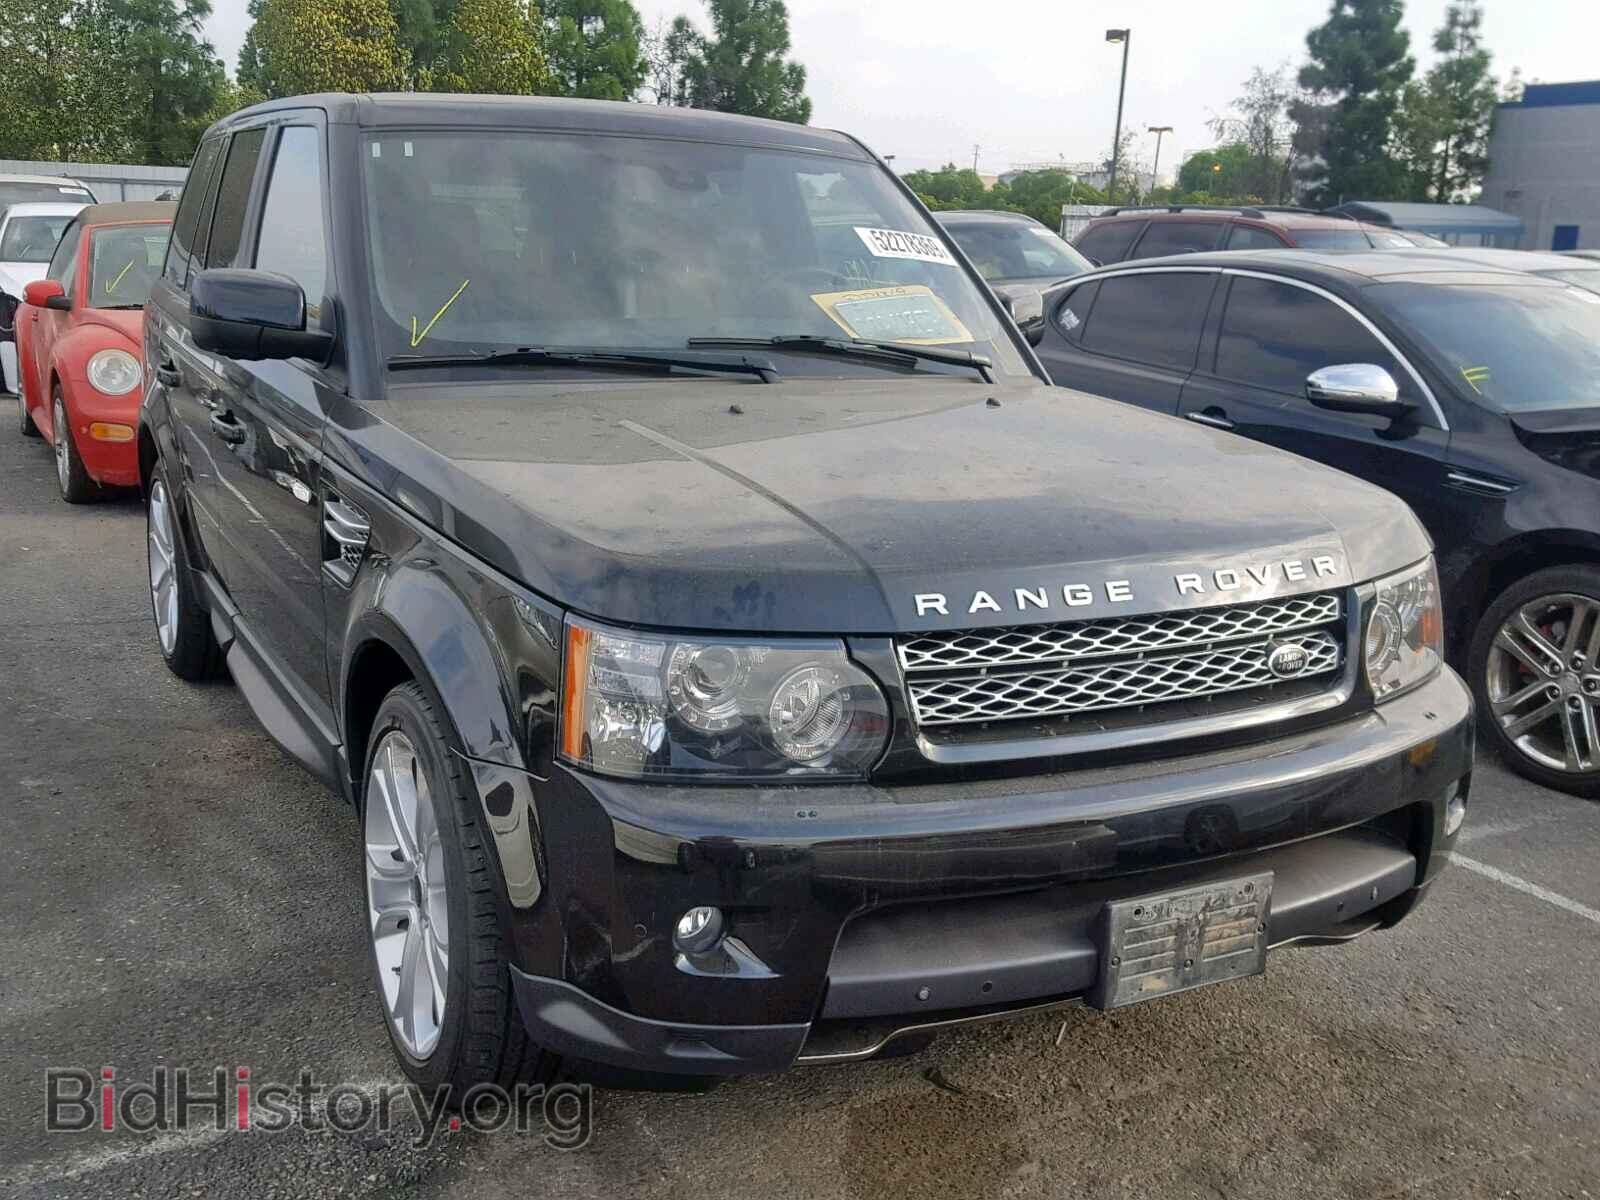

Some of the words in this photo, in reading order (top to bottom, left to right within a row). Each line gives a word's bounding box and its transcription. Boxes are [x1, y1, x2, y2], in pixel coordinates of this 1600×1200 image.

[869, 230, 945, 258] 52278369
[914, 579, 1135, 617] RANGE
[1174, 555, 1337, 595] ROVER
